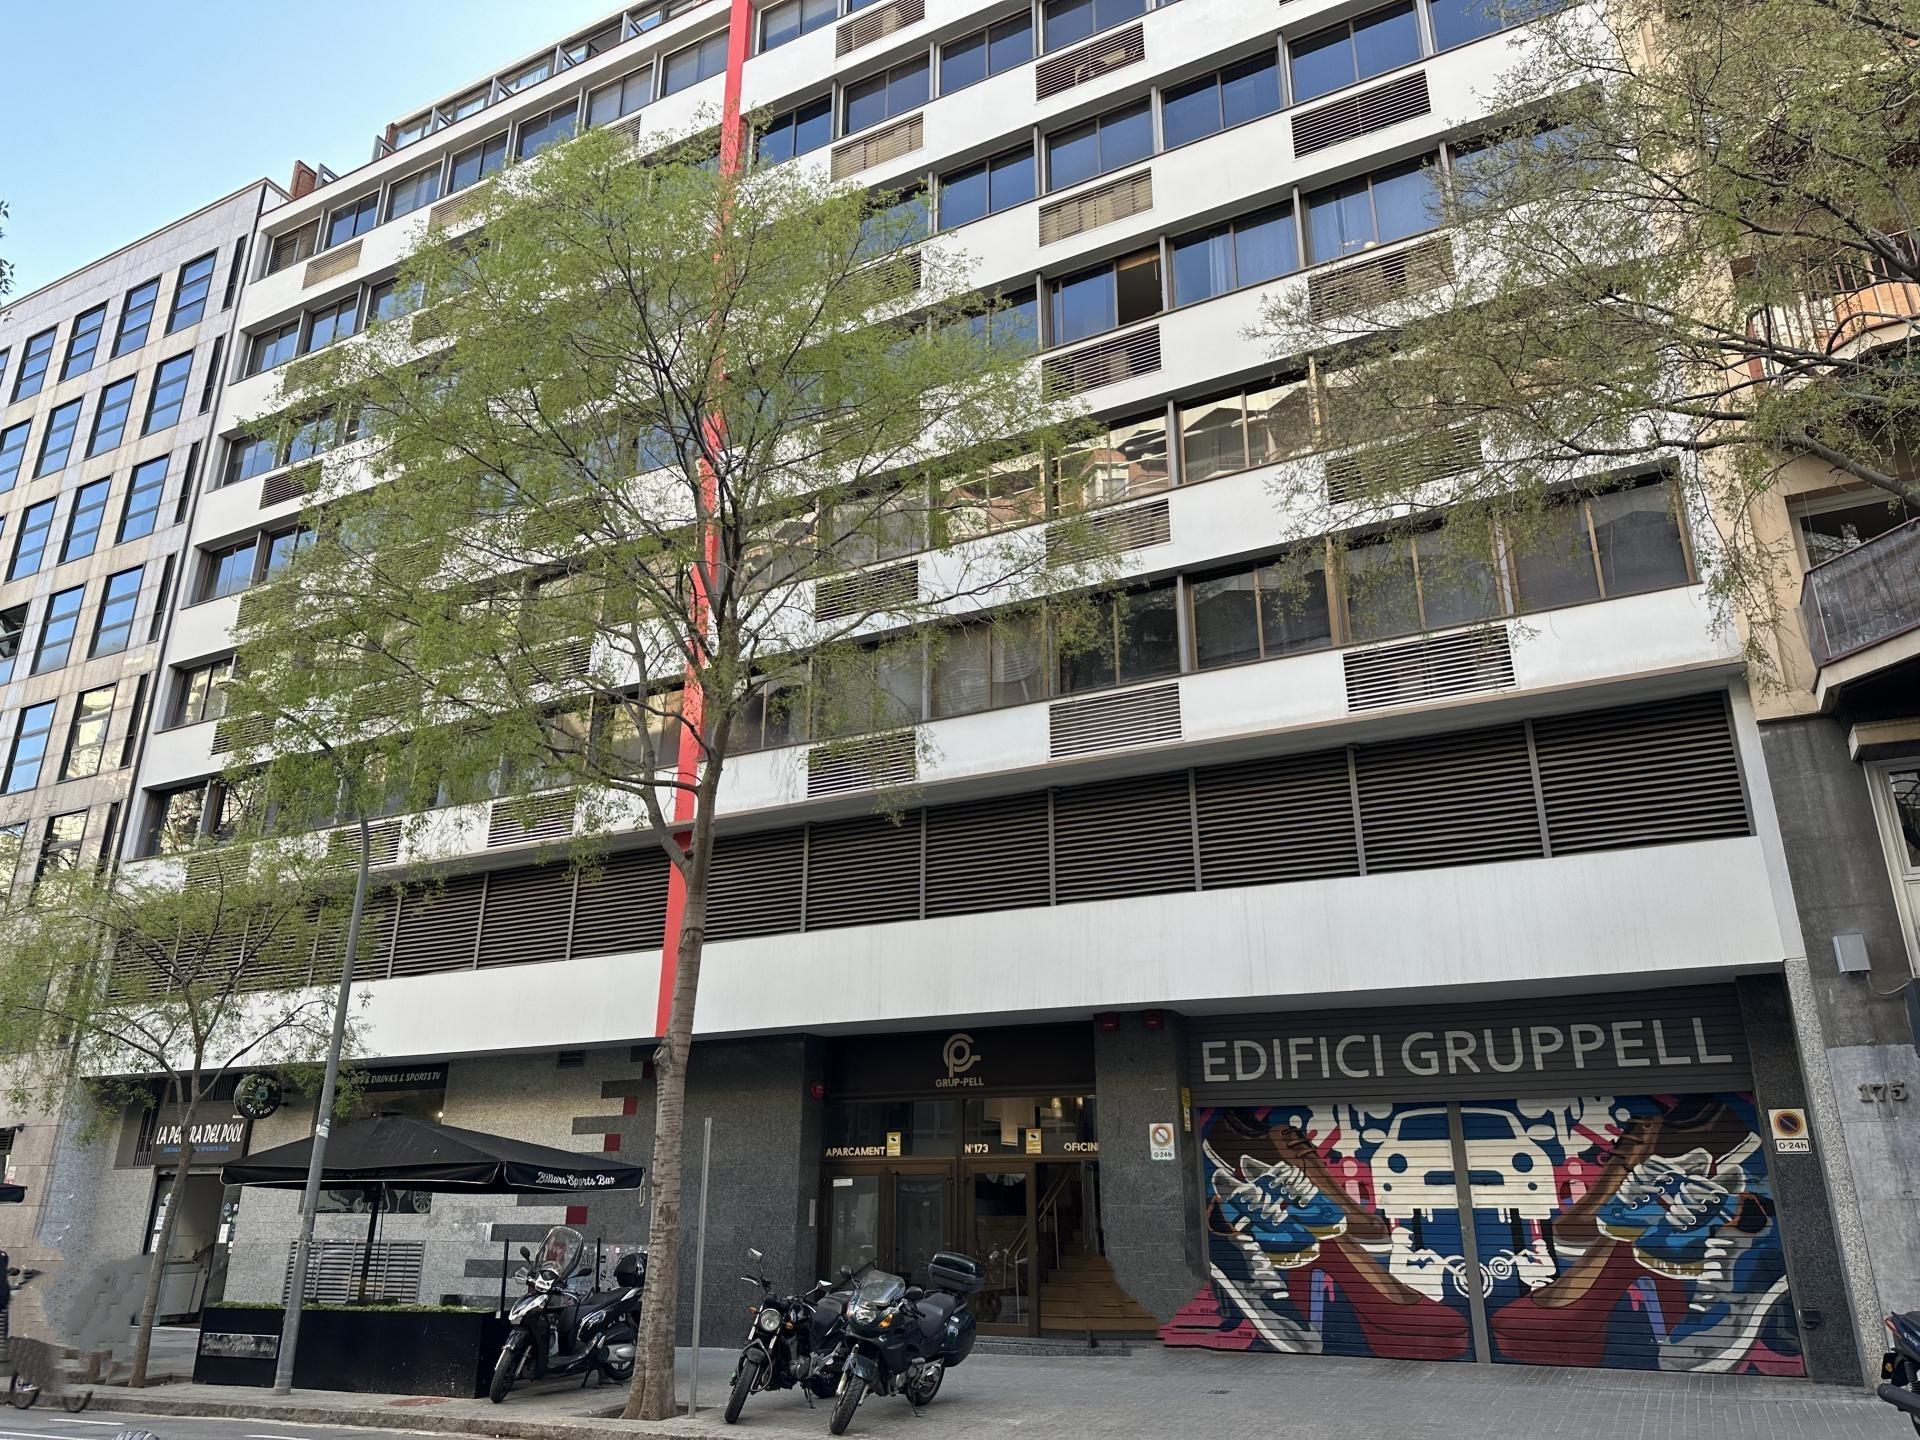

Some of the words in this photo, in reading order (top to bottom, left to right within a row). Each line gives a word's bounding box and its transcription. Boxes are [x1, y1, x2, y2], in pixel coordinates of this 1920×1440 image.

[1202, 1034, 1385, 1082] EDIFICI
[1401, 1017, 1733, 1076] GRUPPELL
[371, 1073, 399, 1084] DRINKS
[406, 1072, 432, 1082] SPORTS
[432, 1071, 441, 1080] TV
[935, 1077, 985, 1088] GRUP-PELL
[1857, 1081, 1907, 1102] 175
[156, 1126, 168, 1145] LA
[203, 1123, 221, 1143] DEL
[220, 1122, 244, 1143] POOL
[825, 1146, 886, 1157] APARCAMENT
[1778, 1141, 1808, 1150] 0-24h
[536, 1171, 567, 1185] Billars
[567, 1173, 597, 1188] Sports
[596, 1174, 616, 1186] Bar
